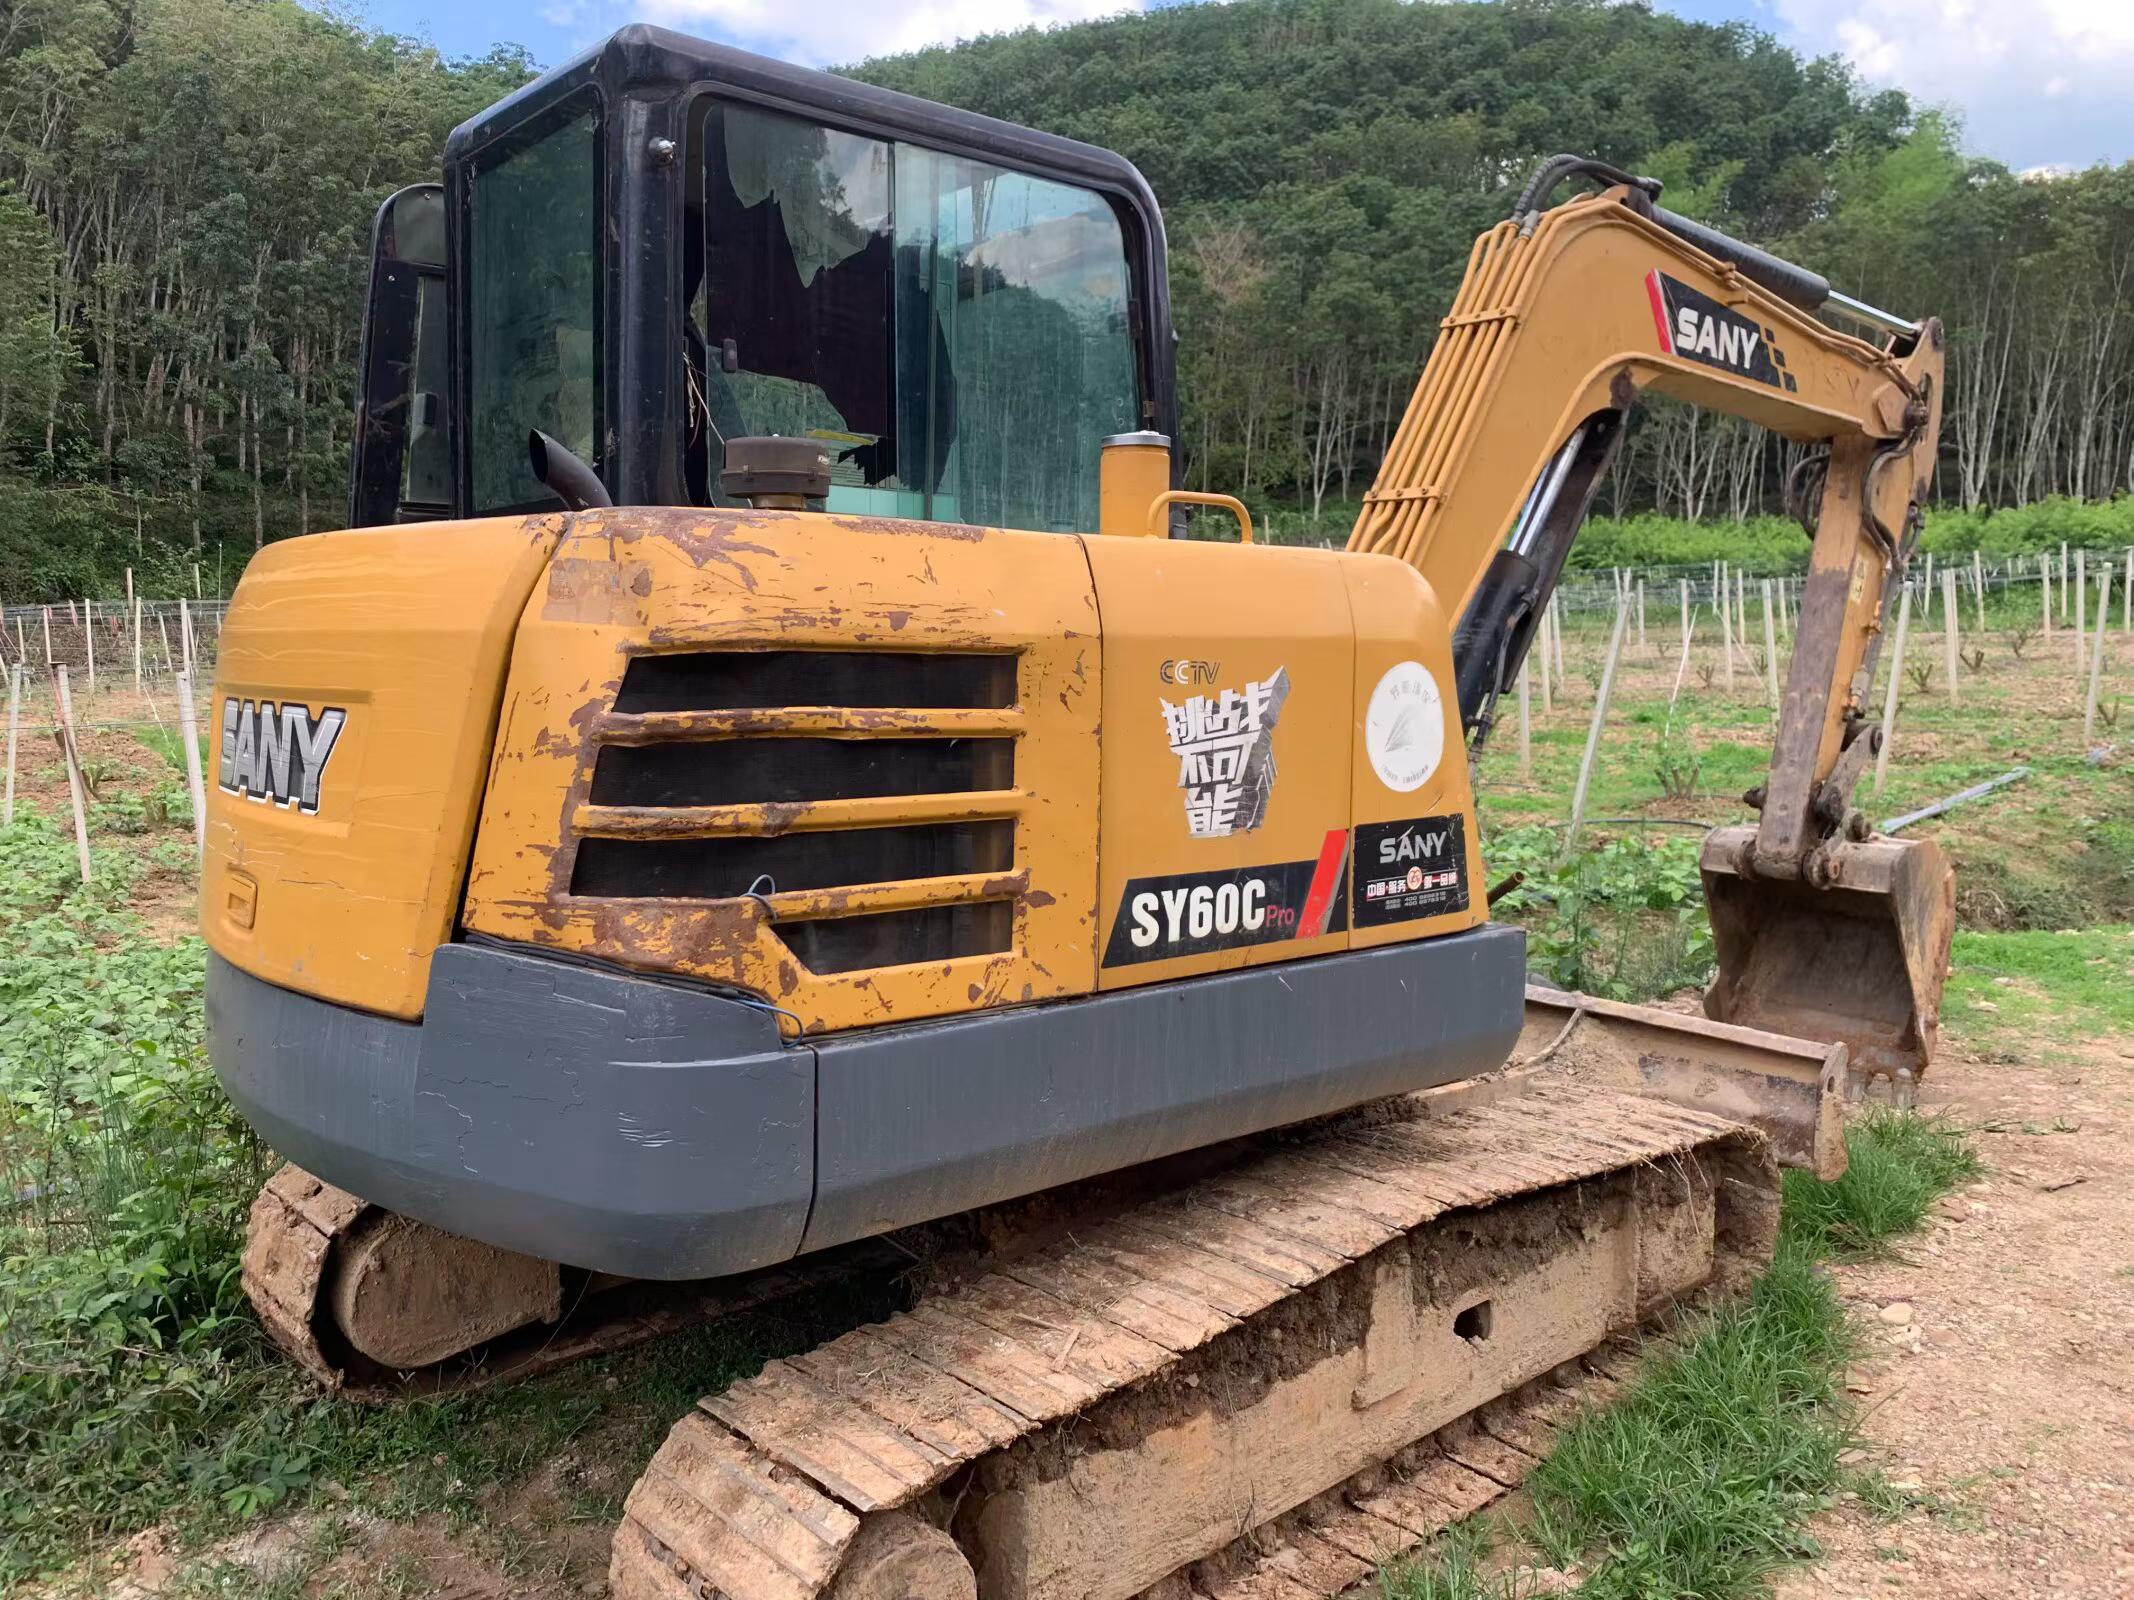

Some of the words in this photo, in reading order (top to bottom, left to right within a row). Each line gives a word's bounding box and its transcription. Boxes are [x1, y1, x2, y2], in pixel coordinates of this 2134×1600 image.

[1677, 307, 1759, 369] SANY
[1160, 660, 1220, 684] CCTV
[1158, 665, 1284, 745] 挑战
[219, 697, 347, 816] SANY
[1184, 783, 1243, 838] 能
[1380, 831, 1447, 864] SANY
[1131, 879, 1266, 947] SY60C
[1265, 904, 1295, 928] Pro
